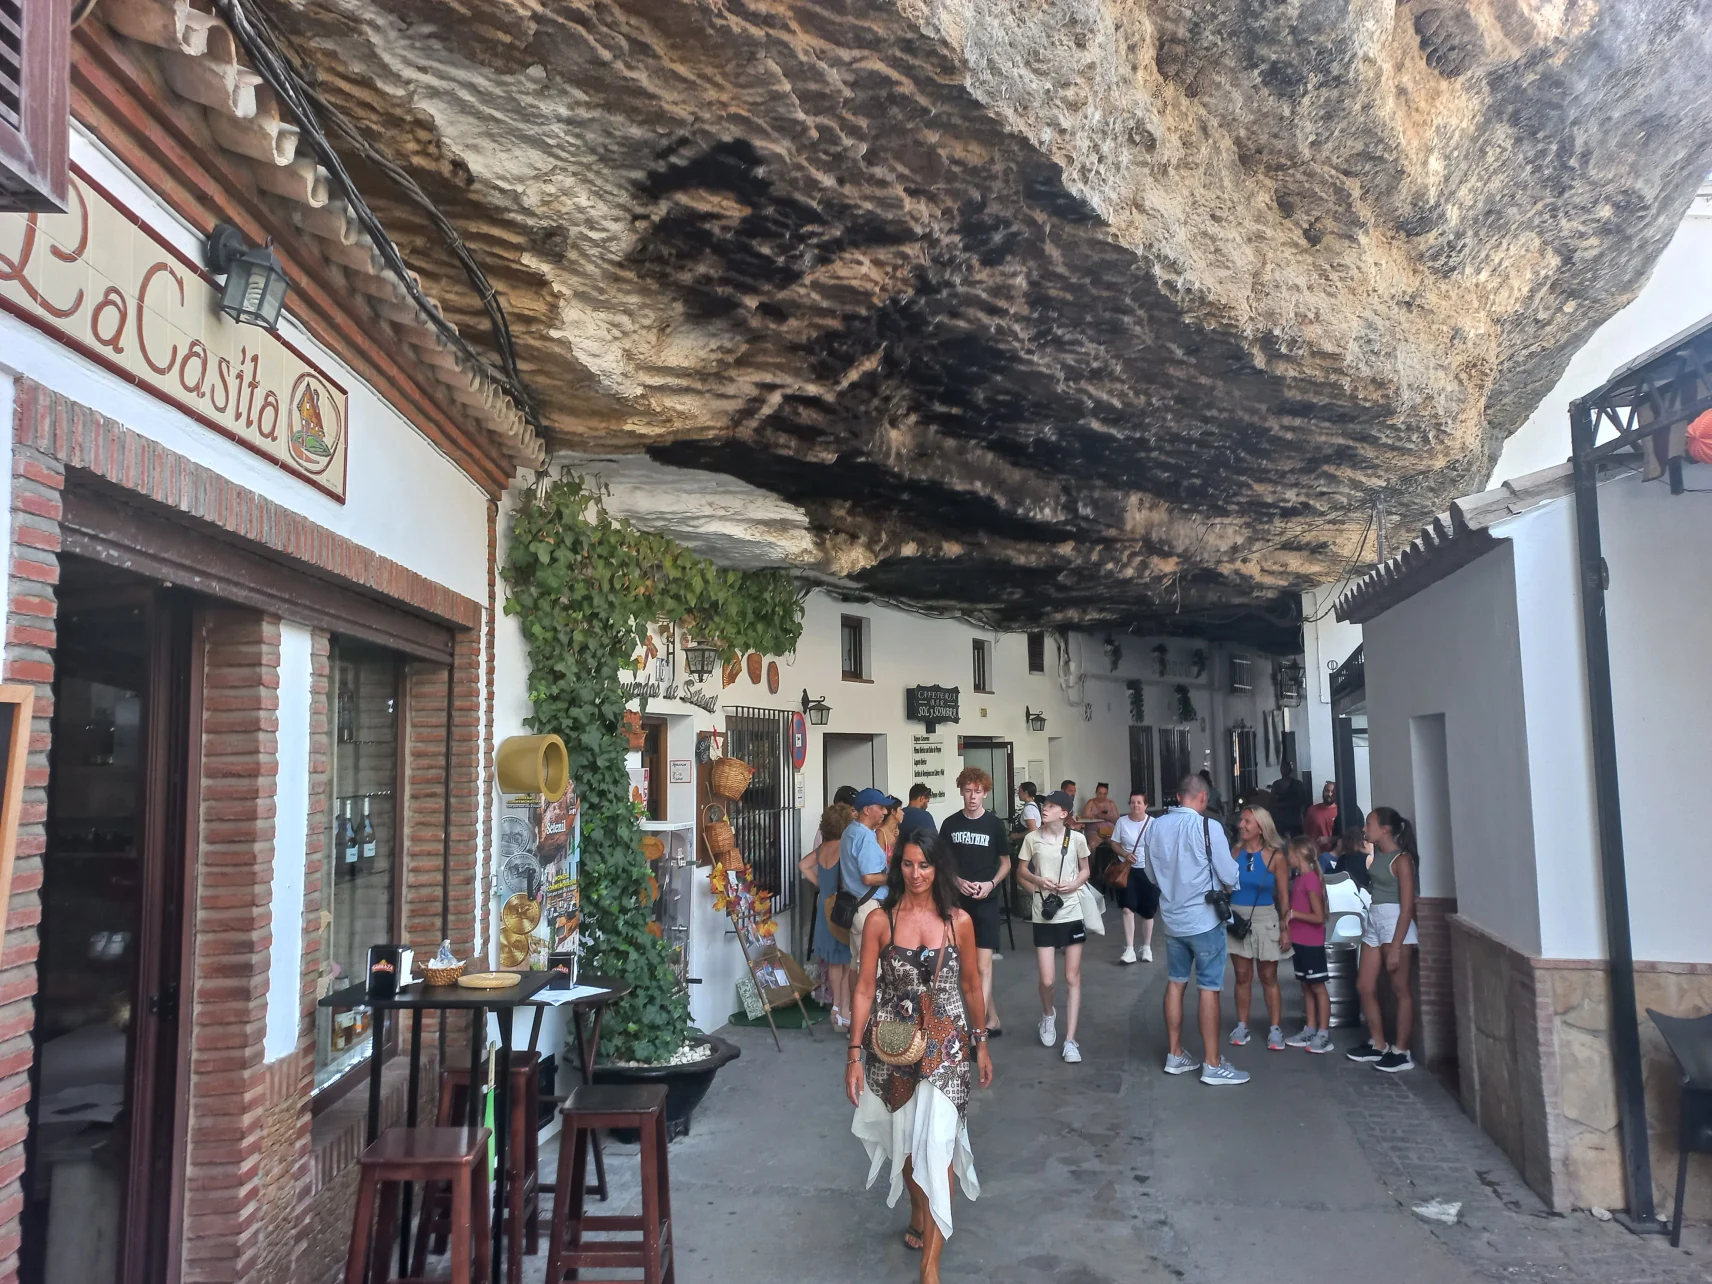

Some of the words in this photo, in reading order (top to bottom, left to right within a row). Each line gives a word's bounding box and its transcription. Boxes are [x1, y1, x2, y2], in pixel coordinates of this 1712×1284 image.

[137, 262, 279, 442] Casita
[664, 684, 678, 699] de
[680, 679, 718, 713] Setenil
[918, 691, 956, 700] CAFETERIA
[918, 706, 930, 716] SOL
[934, 707, 957, 718] SOMBRA
[546, 820, 566, 834] Setenil
[951, 832, 990, 846] GODFATHER
